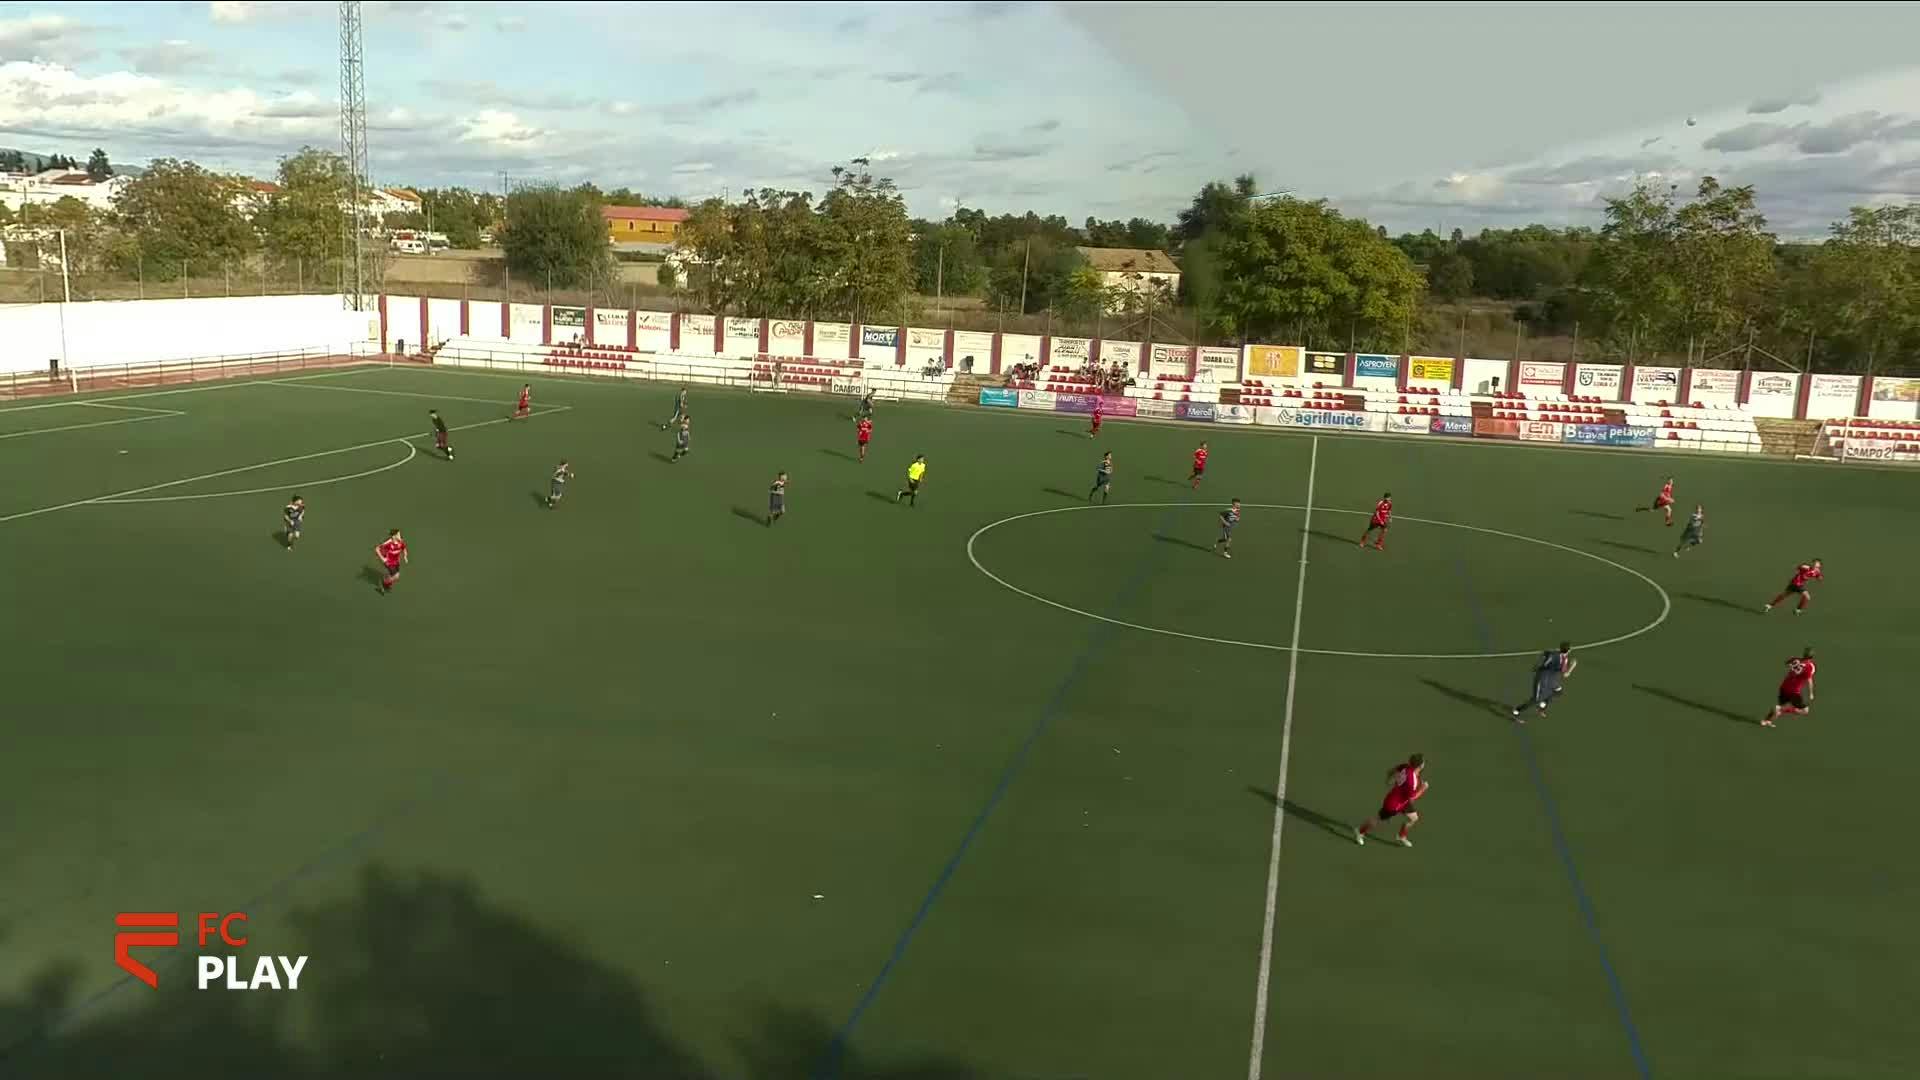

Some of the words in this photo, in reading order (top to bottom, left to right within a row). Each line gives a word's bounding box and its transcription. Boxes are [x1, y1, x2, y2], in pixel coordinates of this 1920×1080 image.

[833, 384, 861, 394] CAMPO
[1295, 411, 1364, 427] agrifluide
[1846, 447, 1883, 458] CAMPO
[1884, 447, 1893, 459] 2
